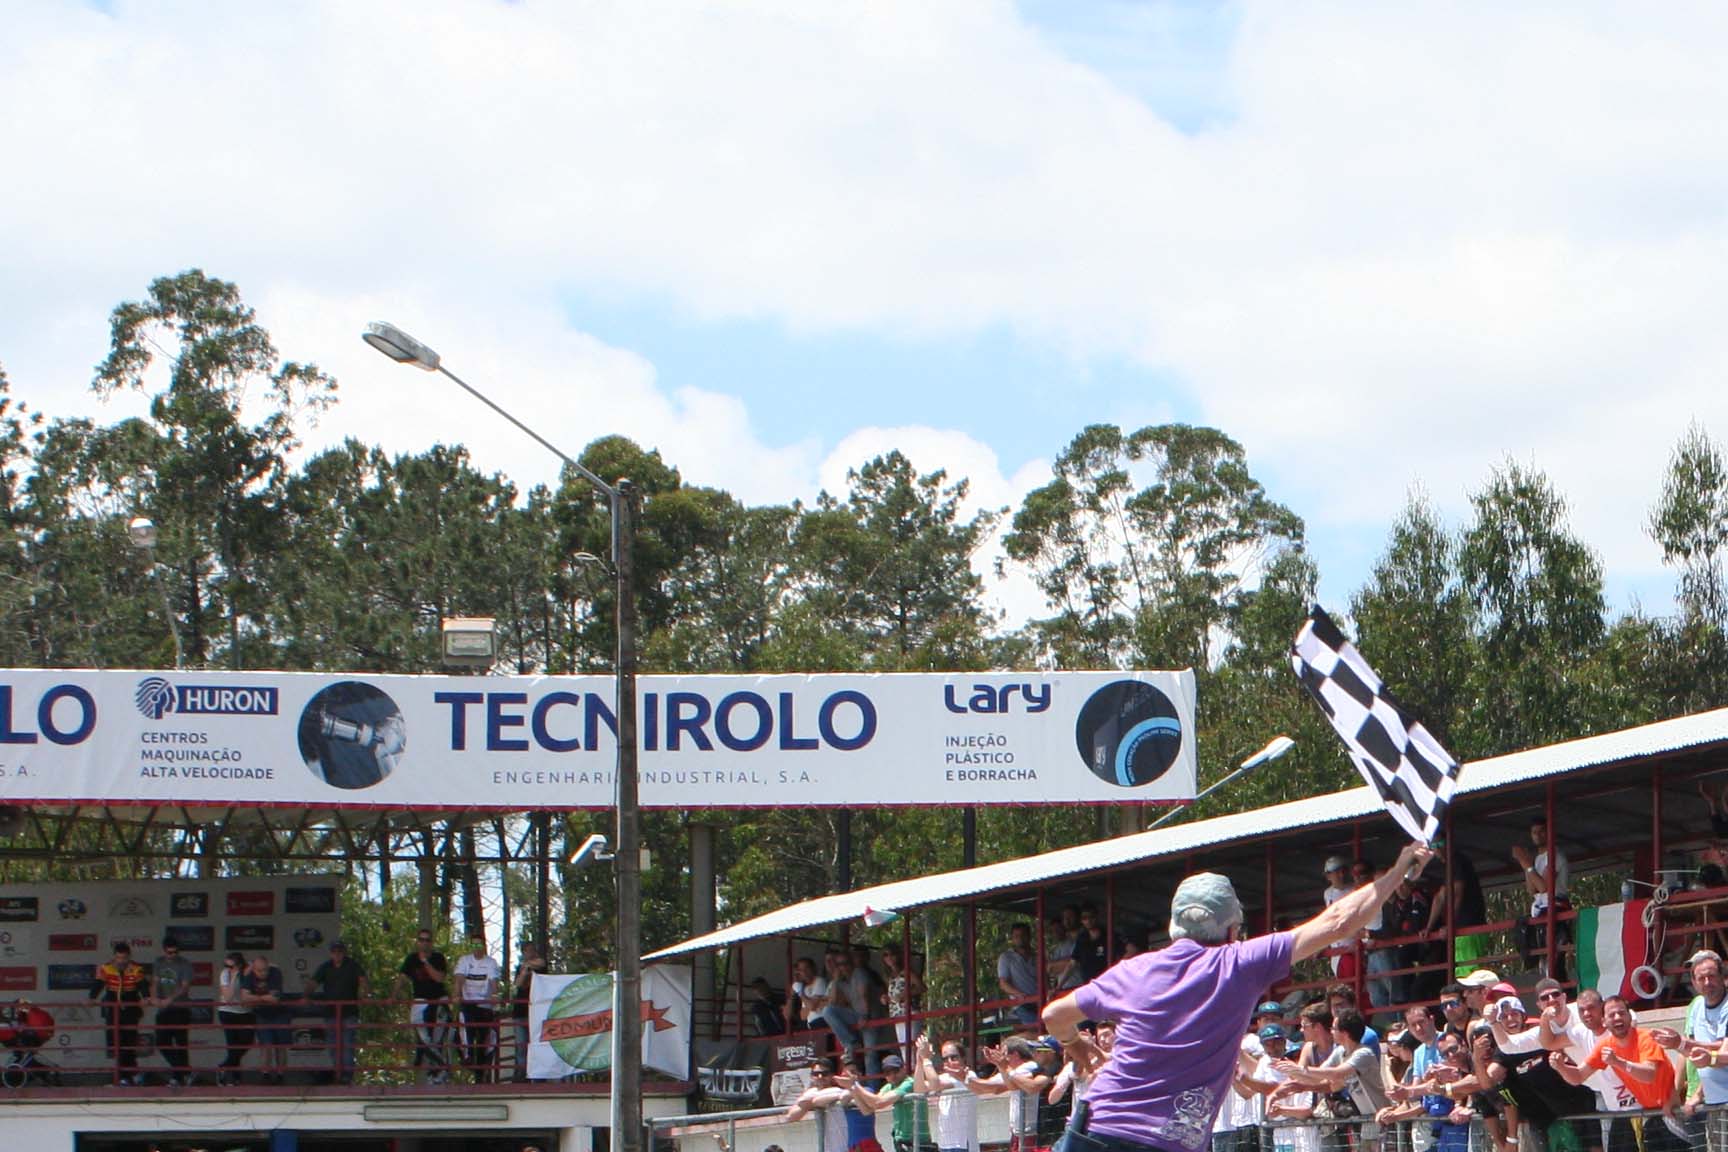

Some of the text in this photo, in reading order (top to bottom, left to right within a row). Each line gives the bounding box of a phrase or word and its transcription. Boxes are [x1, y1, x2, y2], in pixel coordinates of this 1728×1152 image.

[185, 689, 271, 713] HURON
[434, 690, 878, 753] TECNIROLO
[140, 731, 209, 744] CENTROS
[945, 733, 1007, 750] INJEÇÃO
[140, 746, 242, 764] MAQUINAÇÃO
[945, 750, 1015, 764] PLÁSTICO
[140, 766, 275, 780] ALTA VELOCIDADE
[779, 770, 819, 784] S.A.
[945, 769, 1038, 781] E BORRACHA
